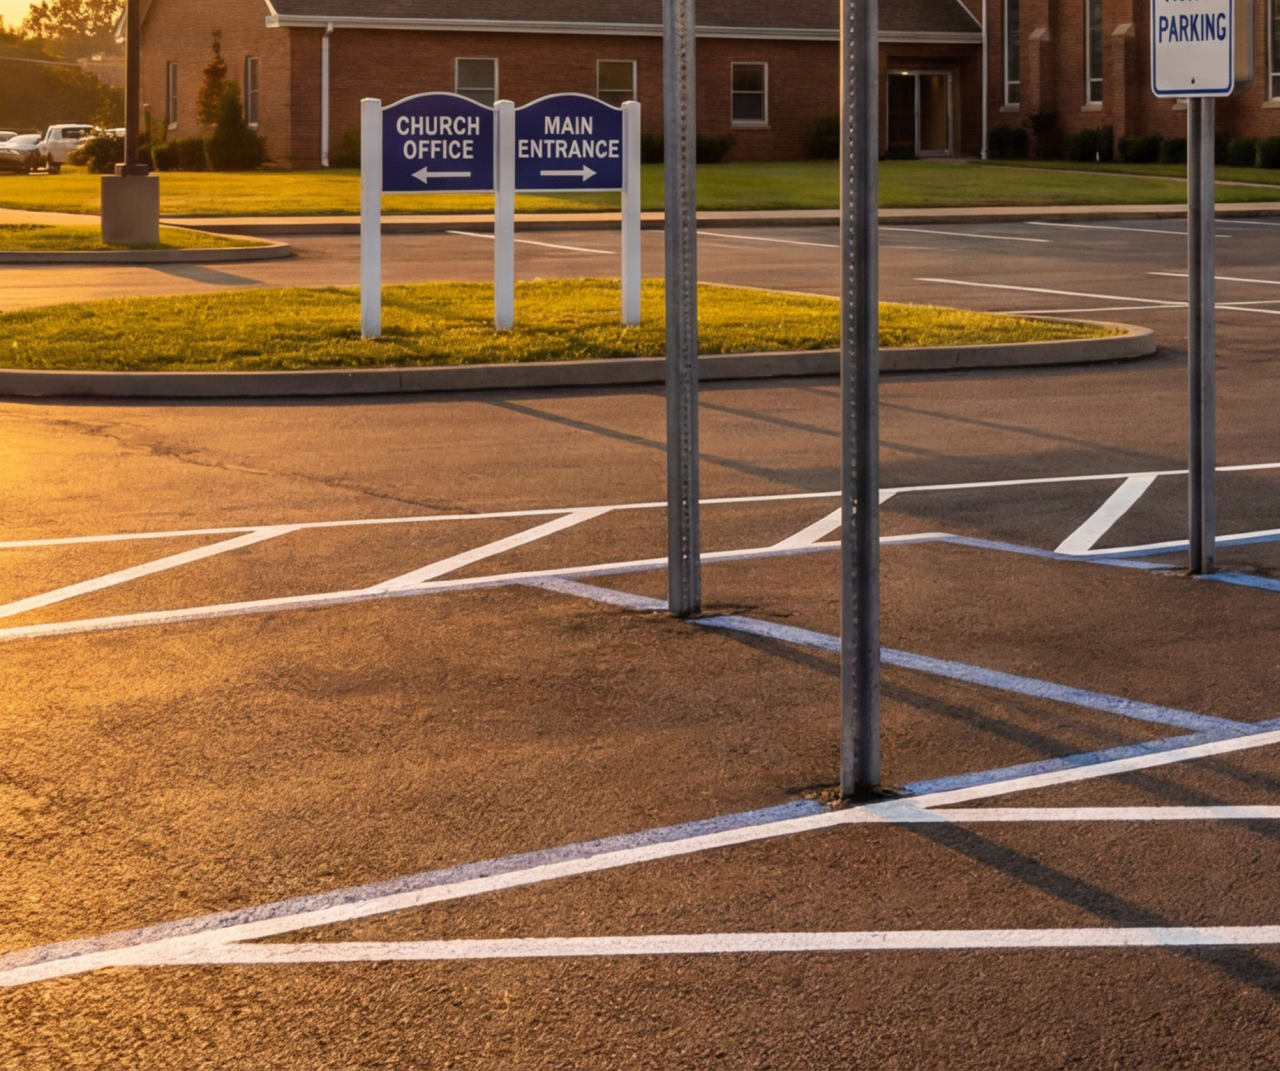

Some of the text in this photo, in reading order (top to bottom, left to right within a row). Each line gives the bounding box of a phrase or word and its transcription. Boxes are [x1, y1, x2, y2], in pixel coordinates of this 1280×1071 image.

[1159, 13, 1226, 43] PARKING
[396, 116, 480, 136] CHURCH
[544, 116, 593, 135] MAIN
[403, 140, 474, 160] OFFICE
[518, 139, 619, 158] ENTRANCE
